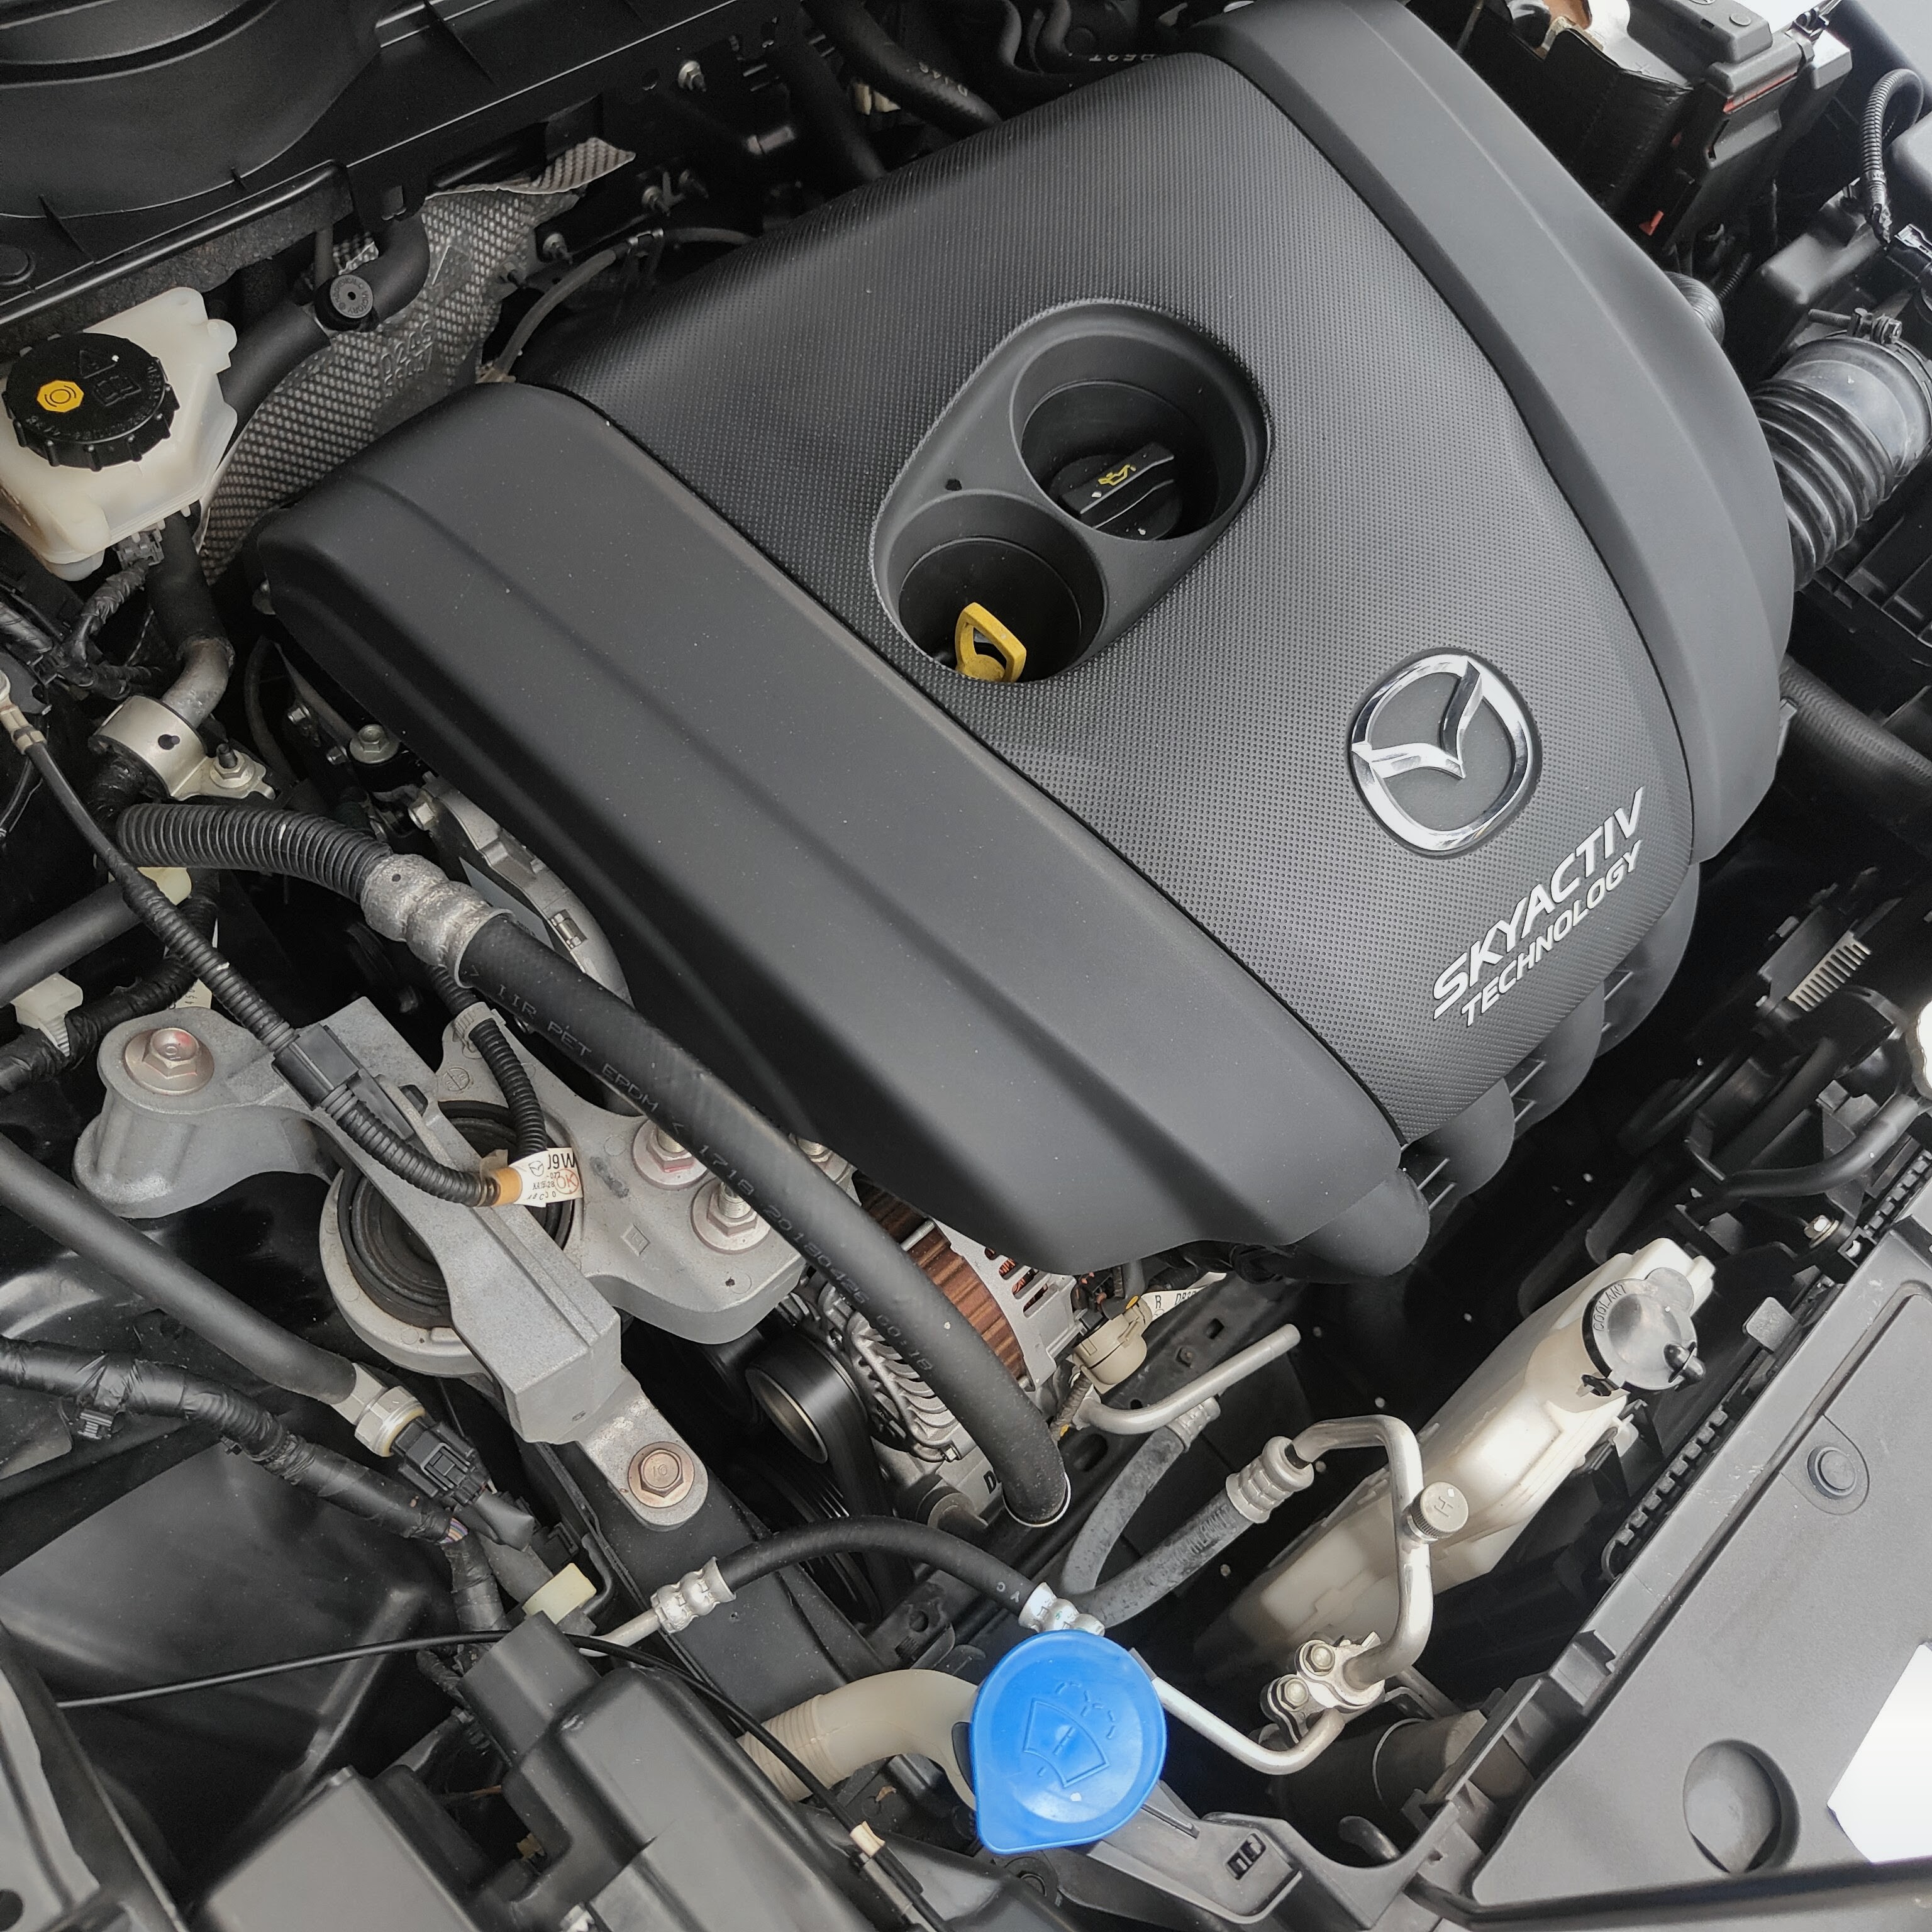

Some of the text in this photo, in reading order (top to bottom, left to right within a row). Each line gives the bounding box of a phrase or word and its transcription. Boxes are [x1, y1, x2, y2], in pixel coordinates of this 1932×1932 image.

[1433, 786, 1644, 1021] SKYACTIV
[1460, 839, 1642, 1028] TECHNOLOGY
[548, 1021, 592, 1057] PET
[601, 1063, 658, 1113] EPDM
[556, 1172, 578, 1189] OK
[1592, 1283, 1627, 1332] COOLANT
